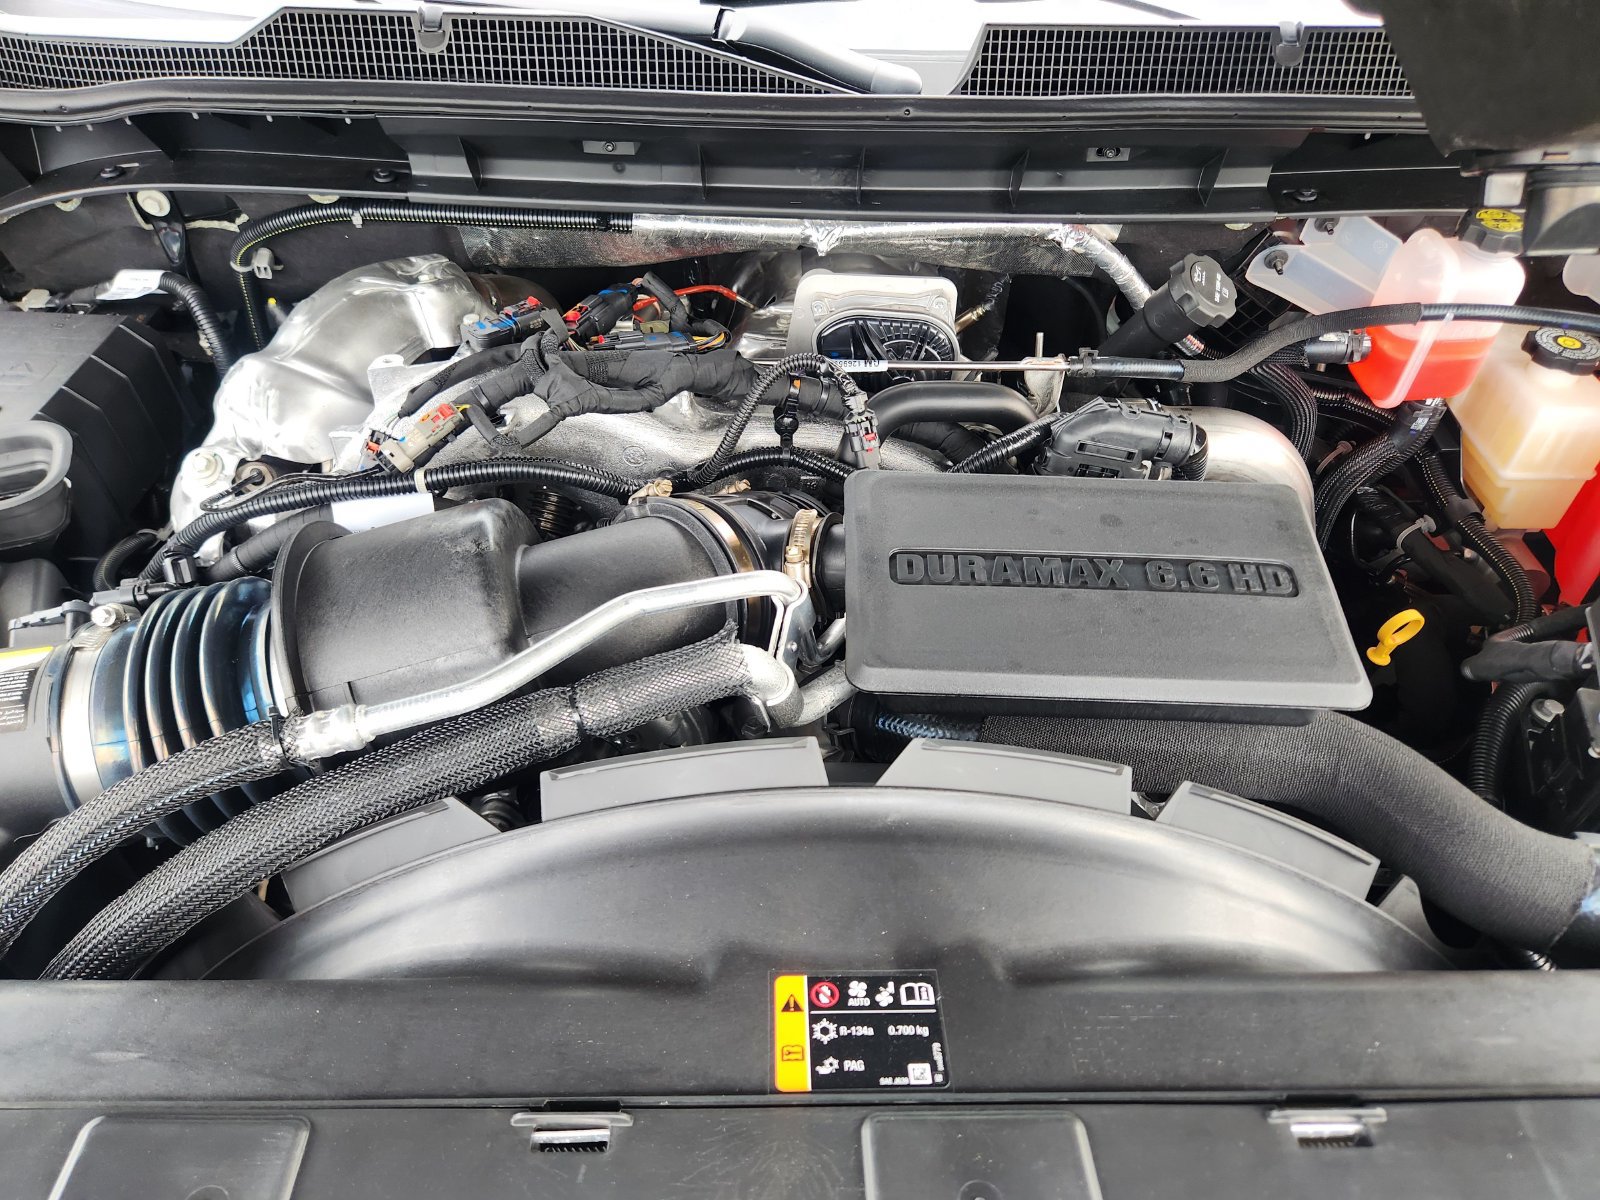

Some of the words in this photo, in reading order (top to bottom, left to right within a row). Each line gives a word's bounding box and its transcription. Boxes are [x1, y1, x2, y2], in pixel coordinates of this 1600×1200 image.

[895, 553, 1129, 588] DURAMAX
[1145, 560, 1220, 591] 6.6
[1227, 563, 1294, 595] HD
[848, 997, 870, 1007] AUTO
[839, 1025, 875, 1036] R-134a
[887, 1024, 915, 1036] 0.700
[915, 1024, 930, 1038] kg
[843, 1059, 865, 1072] PAG
